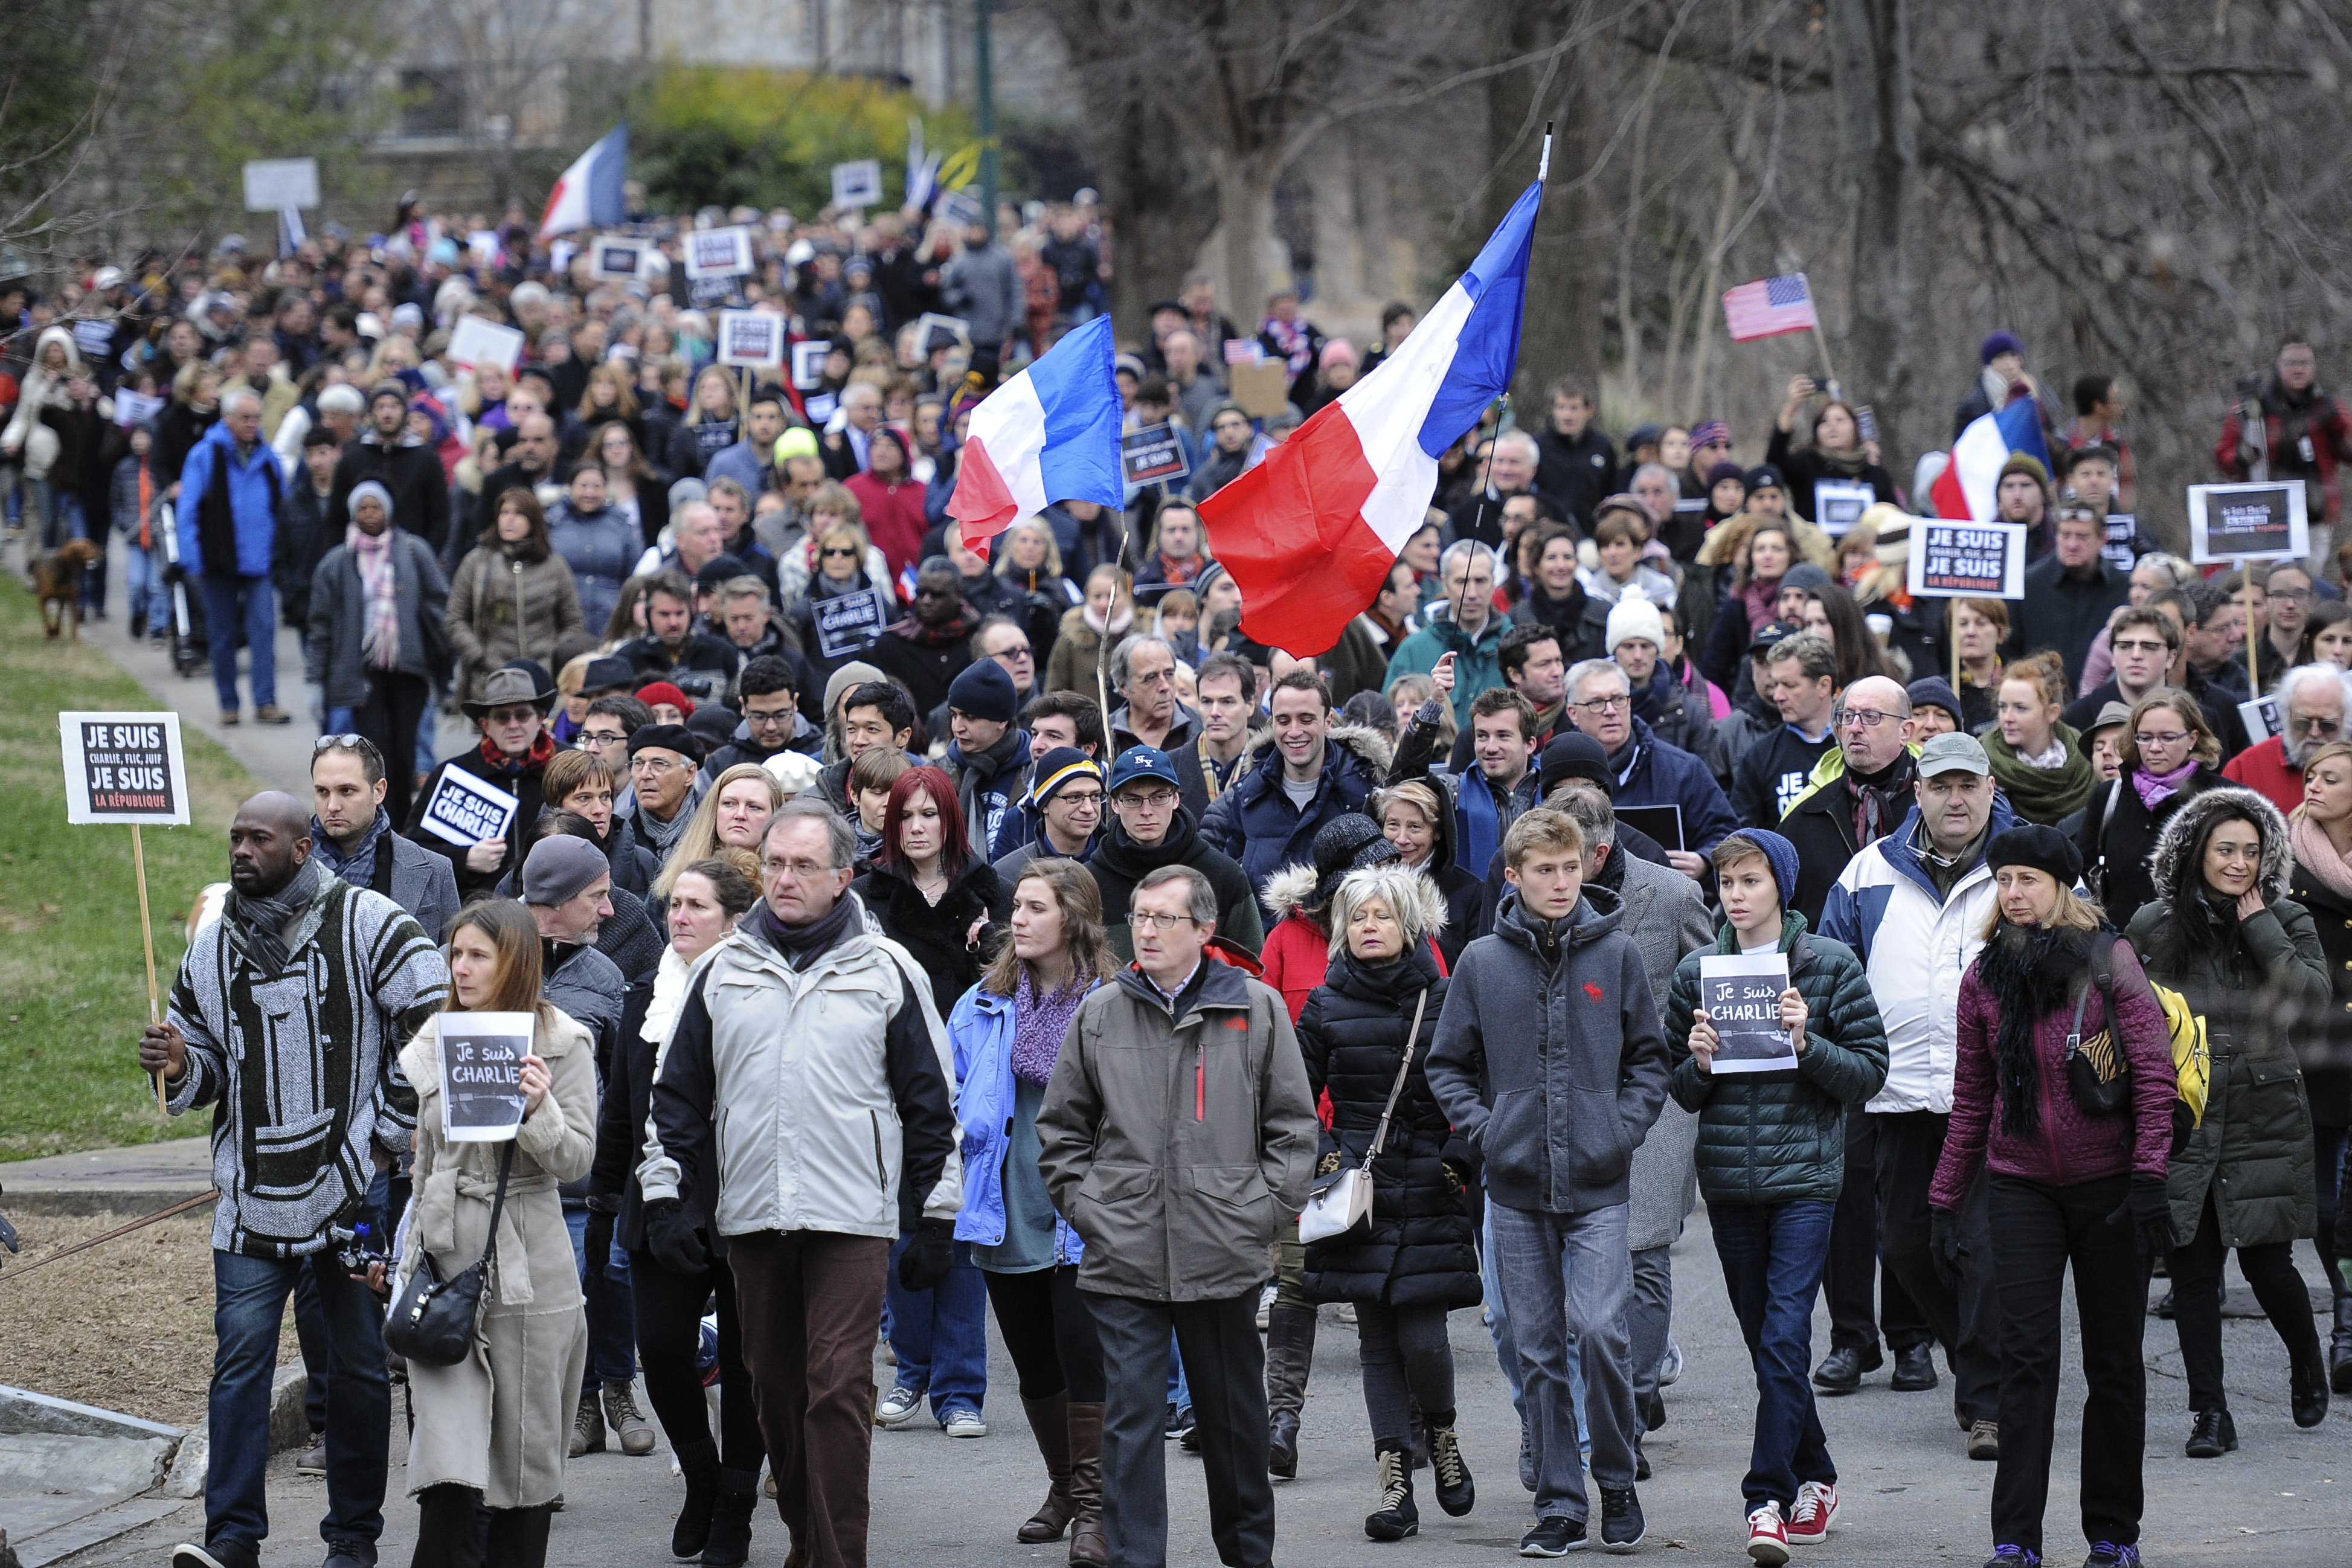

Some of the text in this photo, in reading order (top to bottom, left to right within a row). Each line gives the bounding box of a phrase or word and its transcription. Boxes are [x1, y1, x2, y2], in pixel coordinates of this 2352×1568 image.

[1928, 529, 2003, 550] JE SUIS
[1926, 556, 2001, 578] JE SUIS
[822, 604, 876, 630] CHARLIE
[86, 725, 160, 749] JE SUIS
[89, 753, 162, 765] CHARLIE, FLIC, JUIF
[1134, 755, 1154, 768] NY
[91, 766, 165, 790] JE SUIS
[1776, 771, 1803, 795] JE
[95, 791, 166, 808] LA RÉPUBLIQUE
[442, 785, 503, 824] JE SUIS
[434, 797, 498, 839] CHARLIE
[1716, 982, 1776, 1001] Je suis
[1711, 999, 1781, 1021] CHARLIE
[455, 1042, 515, 1062] Je suis
[452, 1062, 519, 1084] CHARLIE
